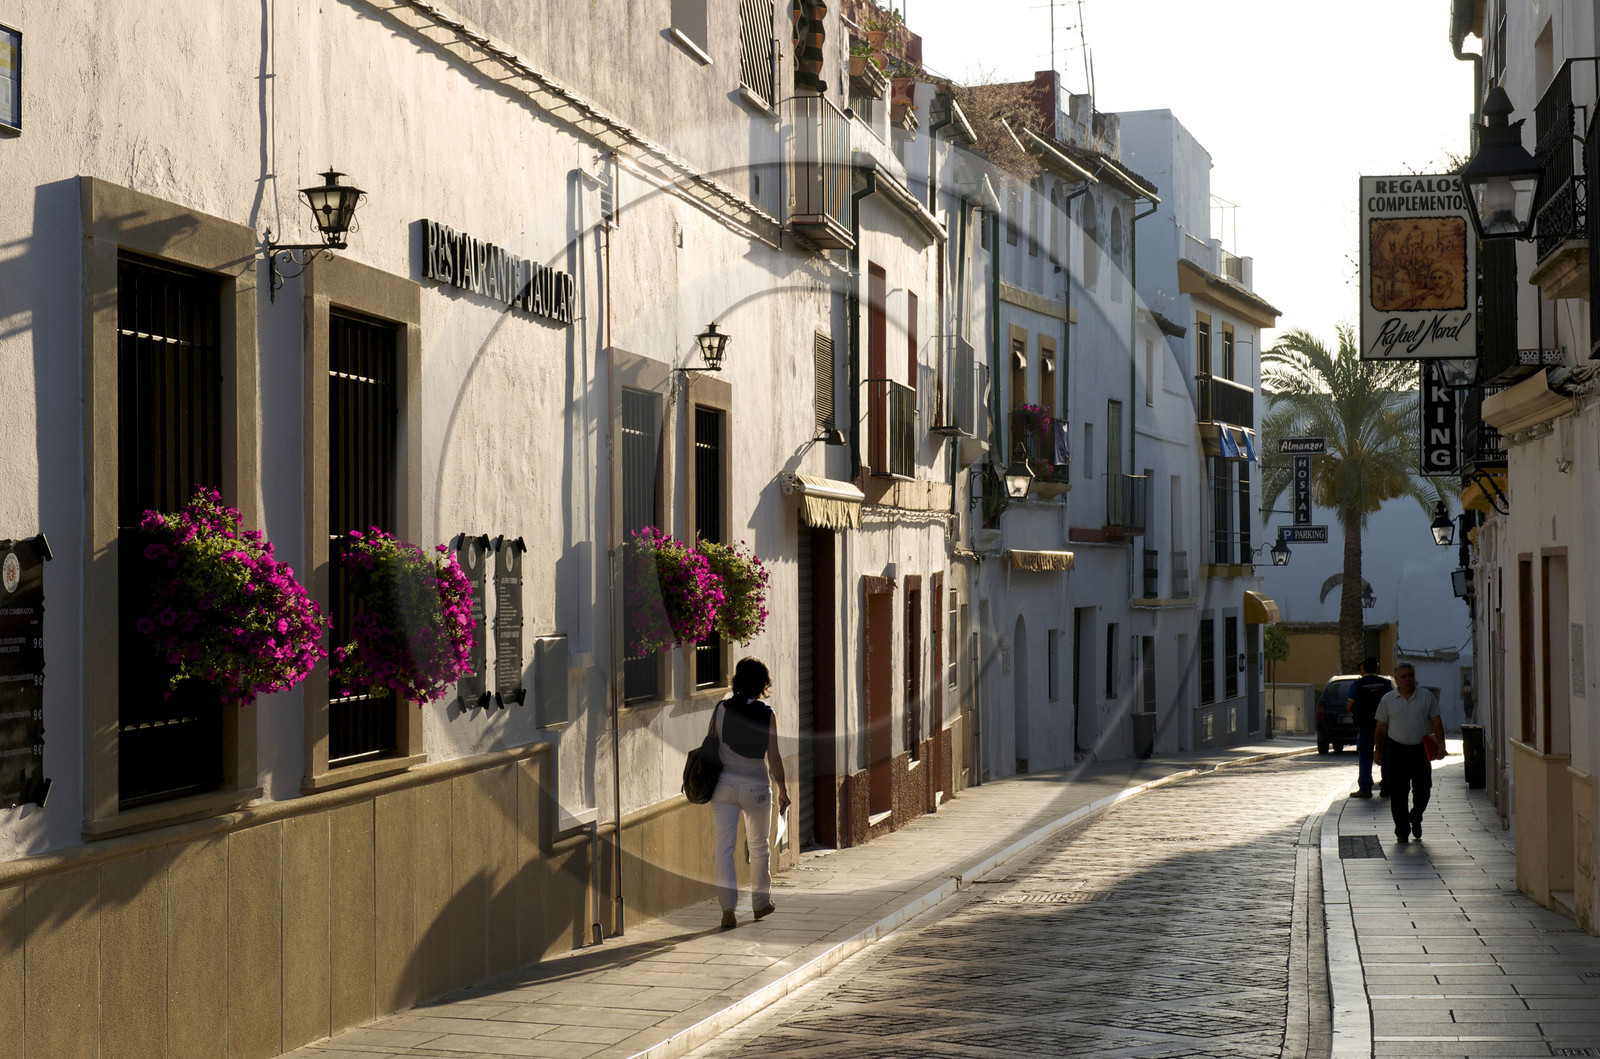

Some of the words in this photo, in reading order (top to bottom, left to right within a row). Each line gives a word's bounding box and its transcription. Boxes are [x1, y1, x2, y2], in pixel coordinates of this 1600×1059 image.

[1375, 178, 1461, 194] REGALOS
[1368, 195, 1467, 213] COMPLEMENTO
[425, 218, 523, 308] RESTAURANTE
[528, 259, 575, 325] JAULAR
[1369, 317, 1426, 357] Rafael
[1280, 440, 1323, 452] Almanzor
[1298, 459, 1307, 522] HOSTAL
[1294, 529, 1325, 540] PARKING
